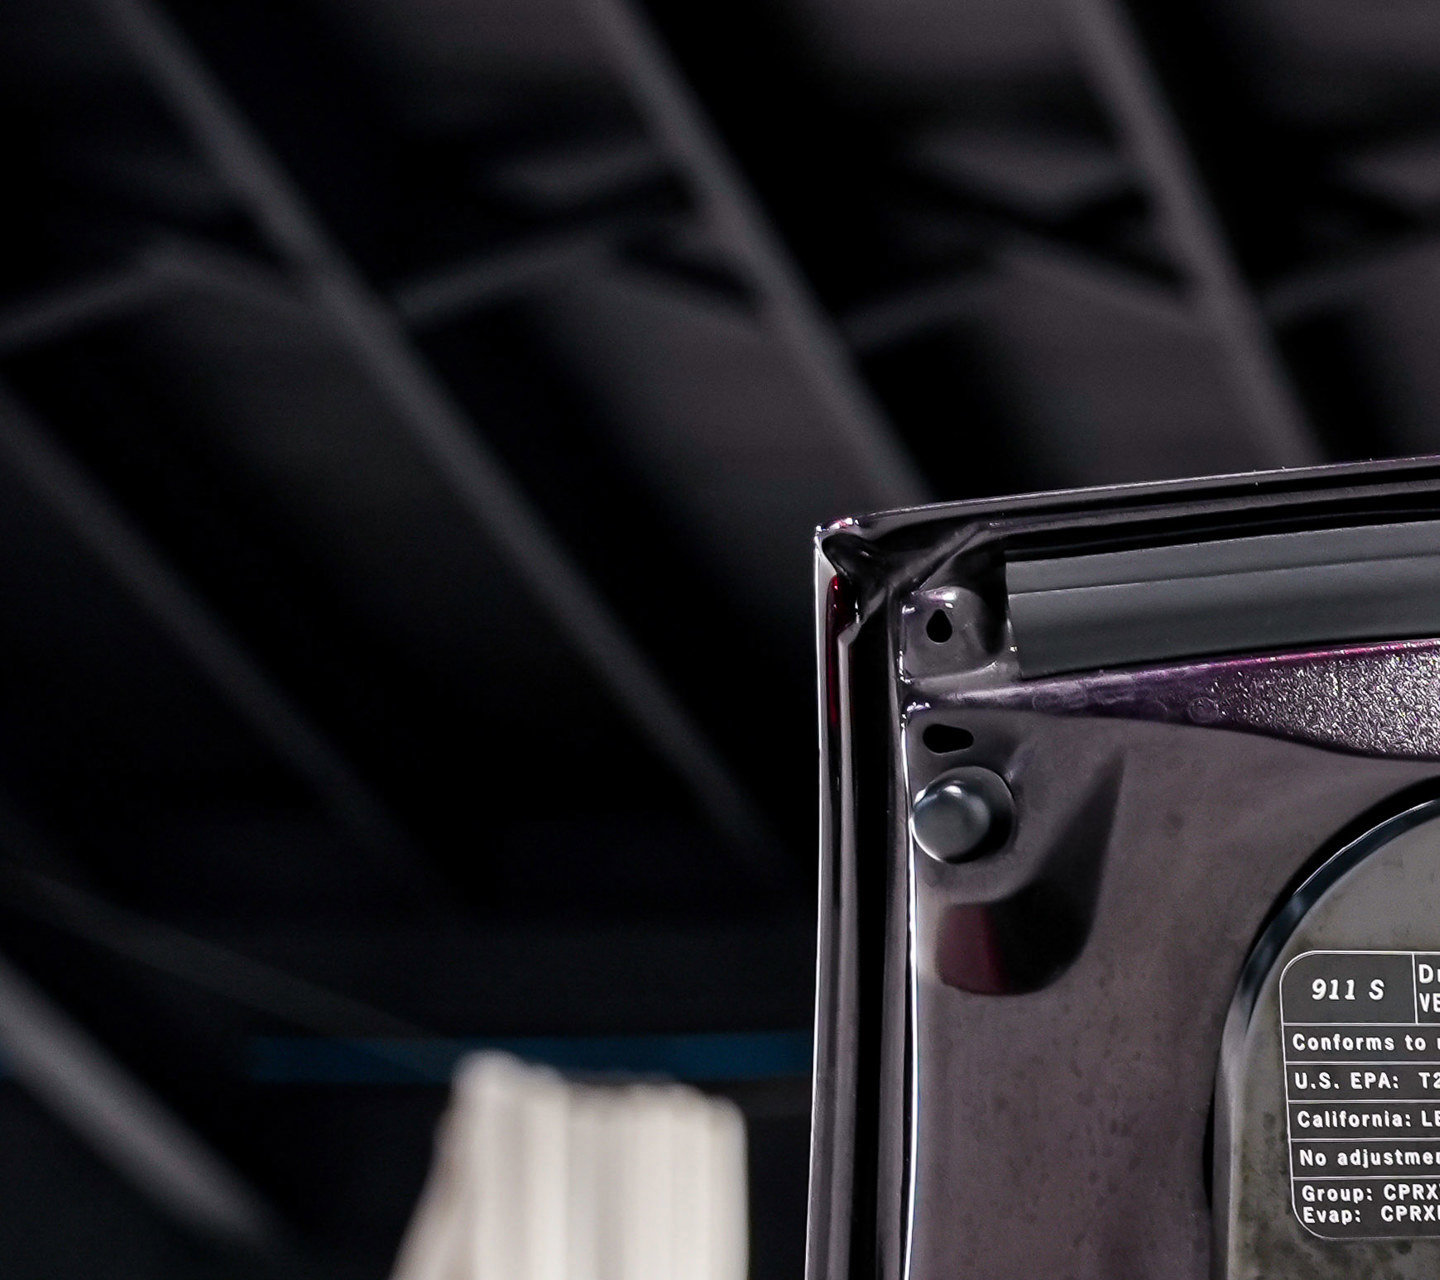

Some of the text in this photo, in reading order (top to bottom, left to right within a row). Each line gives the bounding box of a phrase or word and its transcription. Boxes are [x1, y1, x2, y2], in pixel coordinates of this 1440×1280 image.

[1312, 979, 1384, 1000] 911 S
[1293, 1034, 1394, 1050] Conforms
[1405, 1035, 1426, 1050] to
[1295, 1072, 1339, 1089] U.S.
[1351, 1072, 1398, 1089] EPA:
[1297, 1111, 1411, 1128] California:
[1300, 1150, 1326, 1166] No
[1302, 1185, 1372, 1203] Group:
[1303, 1207, 1360, 1225] Evap:
